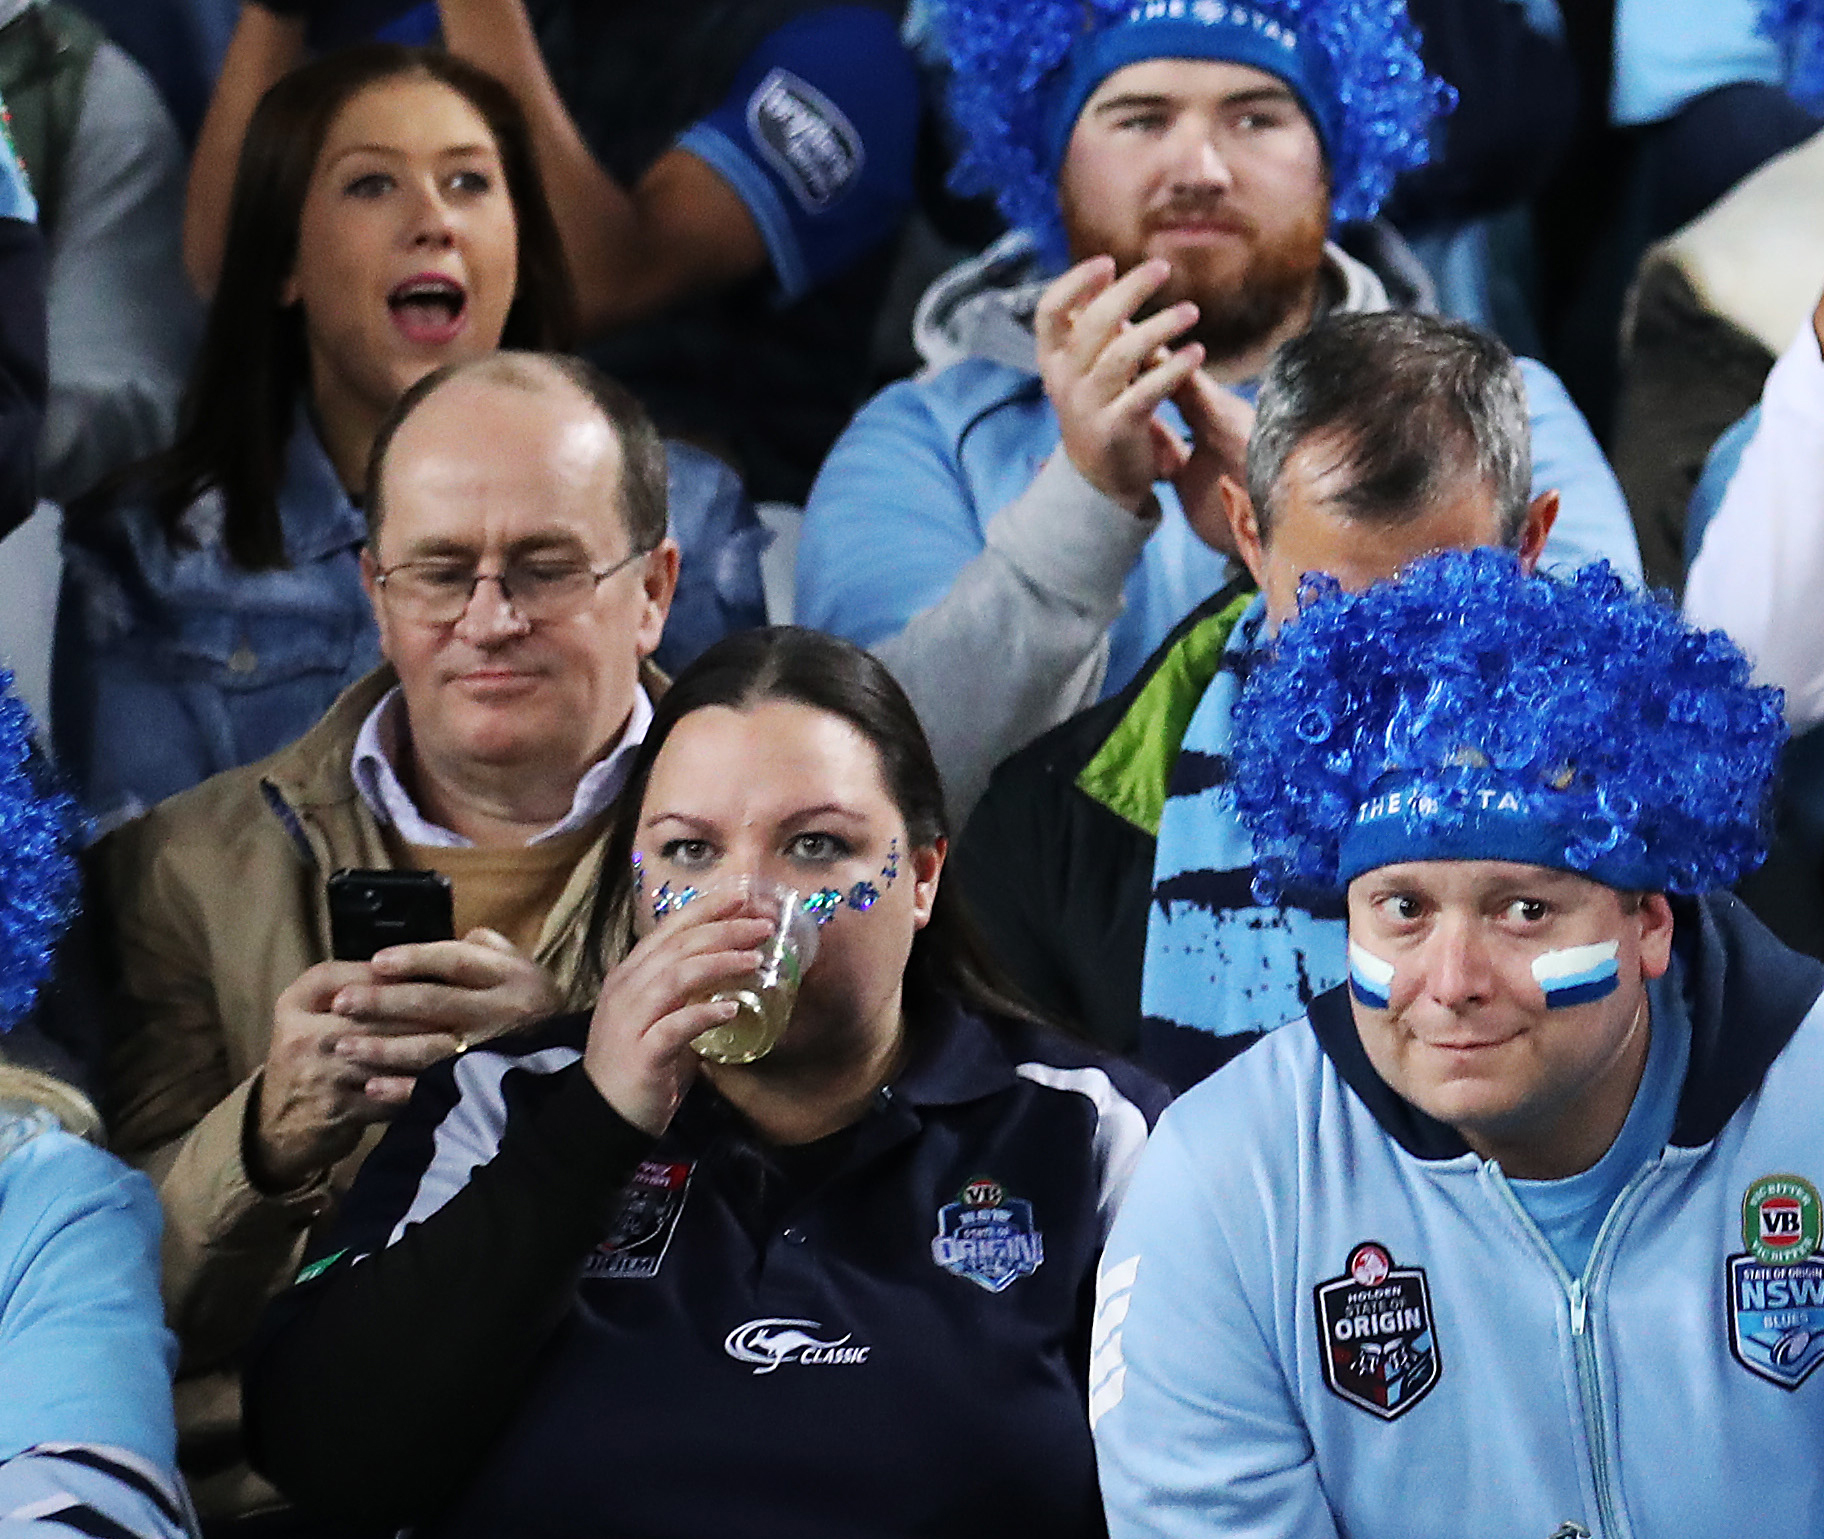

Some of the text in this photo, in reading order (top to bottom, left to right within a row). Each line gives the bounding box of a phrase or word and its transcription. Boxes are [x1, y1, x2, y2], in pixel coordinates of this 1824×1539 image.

[1230, 5, 1298, 52] STAR
[1359, 792, 1401, 823] THE
[1762, 1212, 1800, 1233] VB
[1743, 1267, 1823, 1282] STATE OF ORIGIN
[1347, 1285, 1402, 1304] HOLDEN
[1344, 1296, 1408, 1319] STATE OF
[1335, 1306, 1422, 1341] ORIGIN
[1763, 1313, 1809, 1329] BLUES
[799, 1346, 872, 1366] CLASSIC
